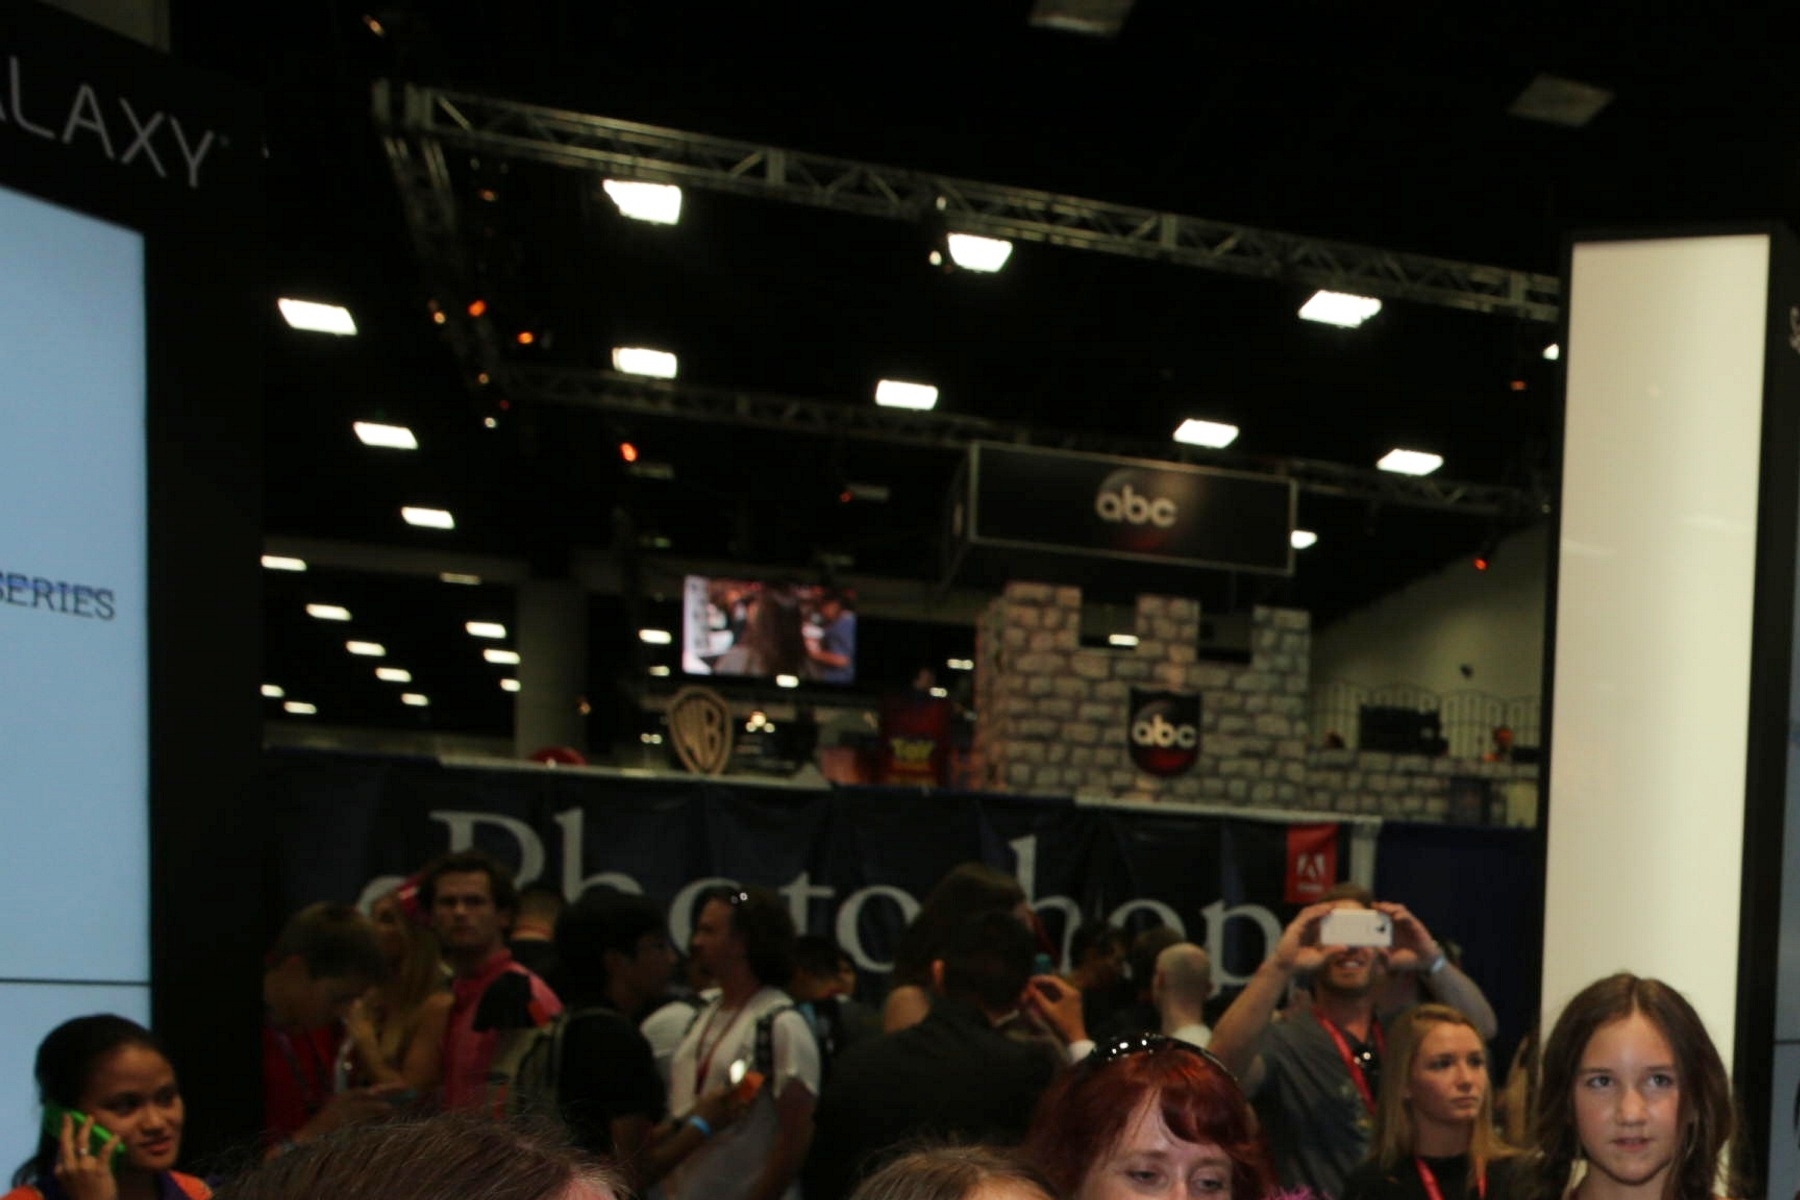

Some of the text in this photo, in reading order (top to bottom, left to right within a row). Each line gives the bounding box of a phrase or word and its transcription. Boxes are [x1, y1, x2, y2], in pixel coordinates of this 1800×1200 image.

[0, 54, 216, 189] LAXY
[1095, 484, 1178, 527] abc
[1132, 713, 1197, 748] abc
